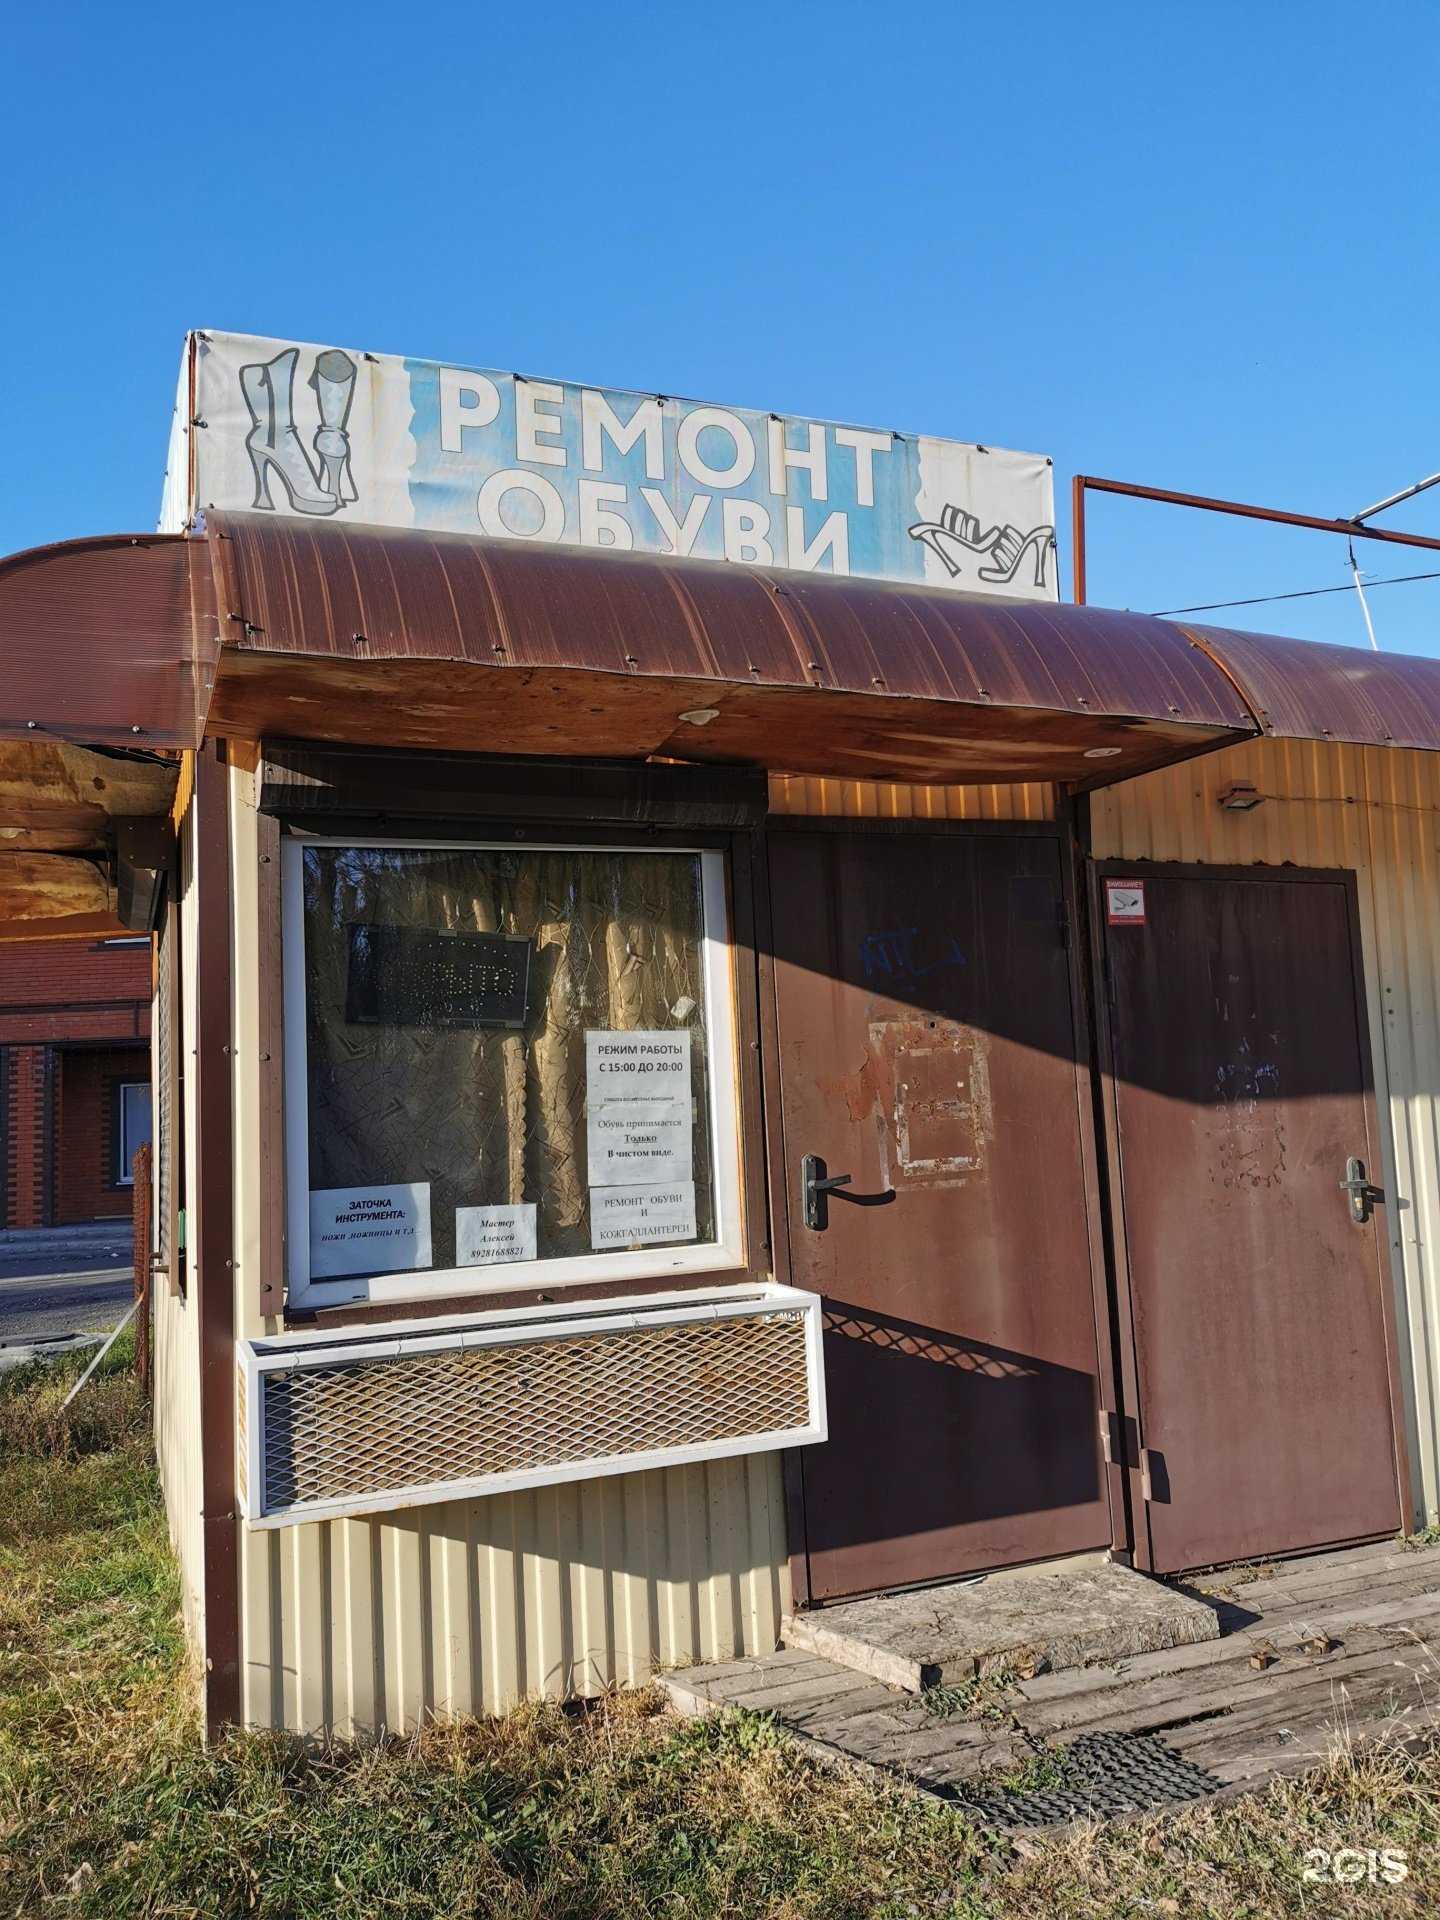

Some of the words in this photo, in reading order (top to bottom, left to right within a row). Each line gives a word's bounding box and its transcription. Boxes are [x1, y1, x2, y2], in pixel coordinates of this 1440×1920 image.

[438, 367, 892, 507] РЕМОНТ
[477, 468, 850, 577] ОБУВИ
[598, 1045, 638, 1055] РЕЖИМ
[640, 1044, 683, 1055] РАБОТЫ
[599, 1063, 606, 1072] С
[608, 1062, 636, 1073] 15:00
[637, 1062, 654, 1074] ДО
[656, 1061, 683, 1072] 20:00
[597, 1120, 624, 1130] Обувь
[626, 1119, 682, 1130] принимается
[624, 1134, 657, 1144] Только
[608, 1149, 614, 1158] В
[616, 1149, 649, 1158] чистом
[651, 1148, 674, 1158] виде.
[348, 1199, 392, 1210] ЗАТОЧКА
[604, 1196, 645, 1208] РЕМОНТ
[650, 1194, 683, 1205] ОБУВИ
[335, 1209, 406, 1224] ИНСТРУМЕНТА:
[640, 1208, 648, 1217] И
[480, 1219, 515, 1229] Мастер
[480, 1232, 515, 1243] Алексей
